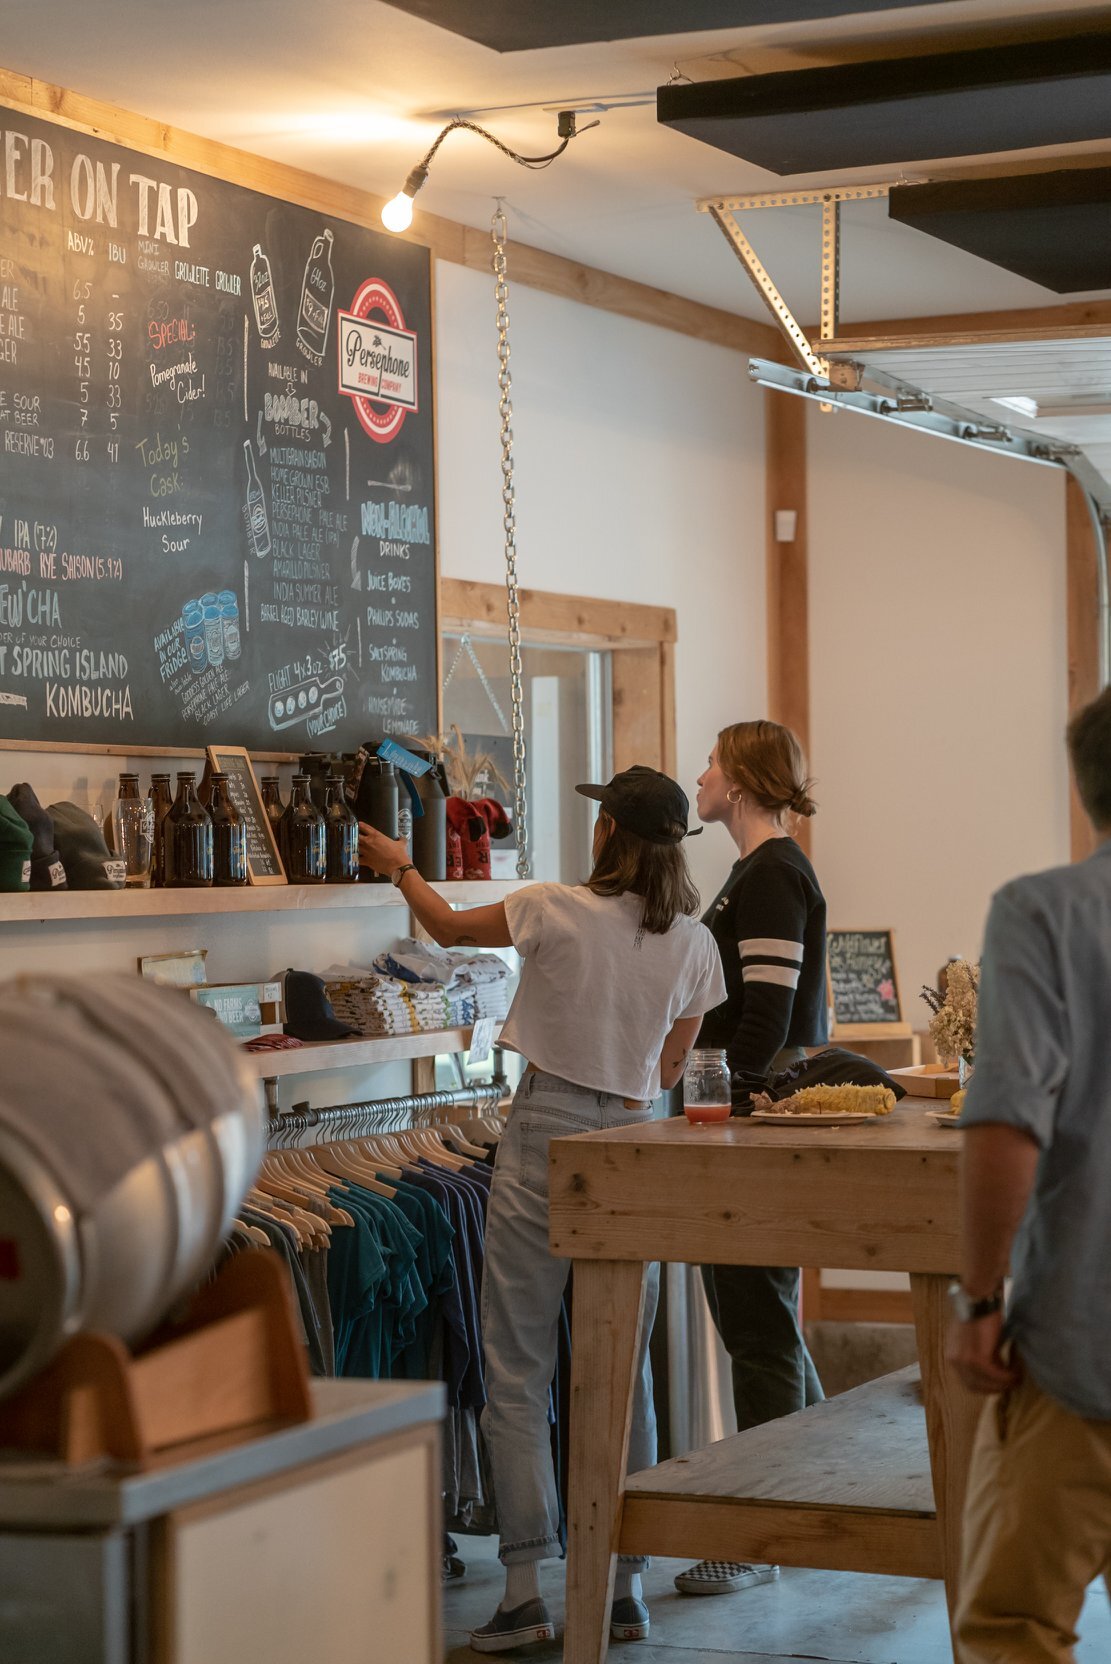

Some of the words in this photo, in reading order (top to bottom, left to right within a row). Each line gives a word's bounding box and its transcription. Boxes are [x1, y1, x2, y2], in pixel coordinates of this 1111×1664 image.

[0, 130, 56, 211] ER
[70, 153, 120, 228] ON
[129, 173, 199, 249] TAP
[67, 230, 94, 256] ABV%
[108, 242, 126, 264] IBU
[138, 240, 160, 256] MINI
[73, 279, 93, 300] 6.5
[138, 256, 169, 276] GROWLER
[174, 260, 210, 288] GROWLETTE
[215, 270, 241, 297] GROWLER
[1, 285, 19, 312] ALE
[8, 314, 25, 340] ALE
[77, 304, 86, 325] 5
[108, 311, 124, 331] 35
[73, 332, 91, 354] 5.5
[107, 338, 123, 360] 33
[148, 319, 196, 350] SPECIAL:
[346, 330, 410, 378] Persephone
[74, 355, 91, 378] 4.5
[108, 361, 120, 381] 10
[150, 352, 198, 391] Pomegranate
[268, 361, 298, 382] AVAILABLE
[300, 369, 308, 385] IN
[80, 382, 89, 403] 5
[106, 384, 122, 408] 33
[177, 374, 206, 404] Cider!
[358, 373, 378, 388] BREWING
[381, 379, 402, 394] COMPANY
[14, 392, 41, 413] SOUR
[264, 392, 320, 430] BOMBER
[14, 410, 39, 427] BEER
[80, 408, 89, 427] 7
[110, 413, 119, 430] 5
[5, 430, 39, 457] RESERVE
[274, 423, 311, 442] BOTTLES
[75, 439, 90, 461] 6.6
[107, 441, 119, 463] 41
[315, 474, 331, 496] ESB
[143, 506, 203, 535] Huckleberry
[271, 501, 313, 525] PERSEPHONE
[318, 509, 334, 529] PALE
[334, 512, 349, 533] ALE
[14, 519, 31, 550] IPA
[33, 521, 58, 553] (7%)
[161, 534, 191, 553] Sour
[271, 520, 290, 540] INDIA
[292, 523, 309, 541] PALE
[311, 526, 324, 543] ALE
[272, 538, 295, 558] BLACK
[297, 541, 321, 561] LAGER
[379, 540, 411, 560] DRINKS
[0, 547, 31, 577] UBARB
[39, 552, 57, 579] RYE
[61, 551, 95, 580] SAISON
[95, 556, 123, 581] (5.9%)
[367, 569, 387, 591] JUICE
[273, 581, 295, 602] INDIA
[295, 583, 323, 603] SUMMER
[325, 585, 339, 607] ALE
[296, 606, 319, 629] BARLEY
[319, 609, 340, 633] WINE
[394, 610, 421, 631] SODAS
[30, 634, 48, 648] YOUR
[50, 634, 81, 649] CHOICE
[11, 645, 71, 680] SPRING
[75, 648, 128, 681] ISLAND
[381, 662, 417, 683] KOMBUCHA
[233, 680, 251, 703] LAGER
[268, 664, 291, 693] FLIGHT
[46, 681, 134, 721] KOMBUCHA
[212, 683, 231, 706] LAGER
[382, 717, 420, 737] LEMONADE
[213, 999, 223, 1012] NO
[223, 997, 243, 1011] FARMS
[228, 1010, 244, 1024] BEER
